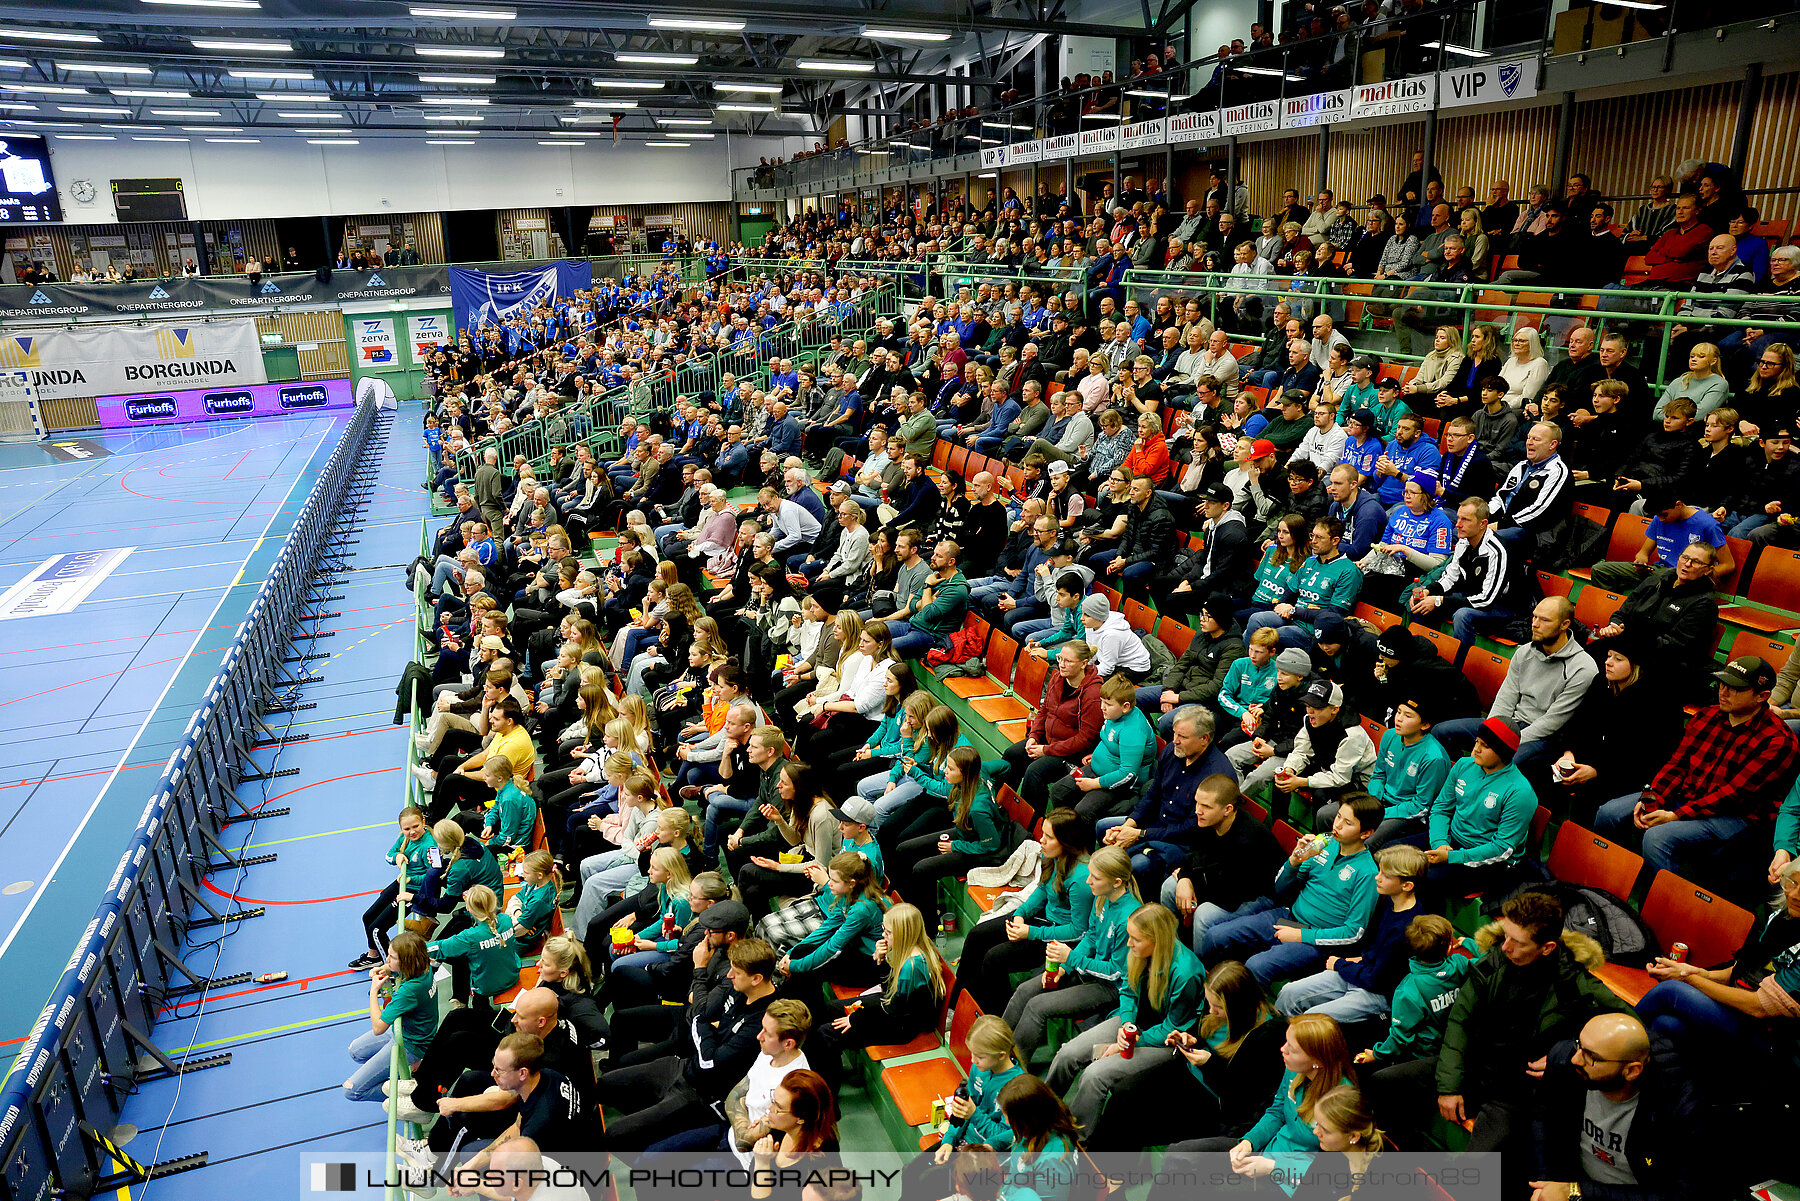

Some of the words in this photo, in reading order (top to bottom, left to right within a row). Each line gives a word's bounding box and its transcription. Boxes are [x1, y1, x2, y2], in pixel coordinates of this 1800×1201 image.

[1360, 75, 1427, 102] mattias
[1451, 71, 1487, 99] VIP
[1287, 90, 1345, 116] mattias
[1363, 101, 1420, 117] CATERING
[1226, 101, 1274, 124] mattias
[1171, 110, 1216, 131] mattias
[1290, 114, 1340, 128] CATERING
[1123, 120, 1162, 138] mattias
[1229, 122, 1269, 134] CATERING
[1082, 127, 1116, 144] mattias
[1174, 130, 1212, 142] CATERING
[1012, 140, 1040, 155] mattias
[1045, 135, 1076, 150] mattias
[1084, 144, 1113, 154] CATERING
[1126, 137, 1158, 148] CATERING
[984, 151, 996, 165] VIP
[111, 182, 118, 192] H
[175, 181, 182, 191] G
[337, 286, 416, 299] ONEPARTNERGROUP
[496, 282, 524, 294] IFK
[116, 300, 204, 312] ONEPARTNERGROUP
[230, 294, 313, 306] ONEPARTNERGROUP
[362, 334, 390, 342] zerva
[415, 330, 444, 339] zerva
[124, 360, 236, 380] BORGUNDA
[156, 378, 210, 386] BYGGHANDEL
[207, 397, 250, 408] Furhoffs
[283, 390, 325, 403] Furhoffs
[129, 402, 174, 414] Furhoffs
[1274, 564, 1285, 579] 7
[1308, 572, 1320, 586] 5
[1262, 579, 1285, 595] coop
